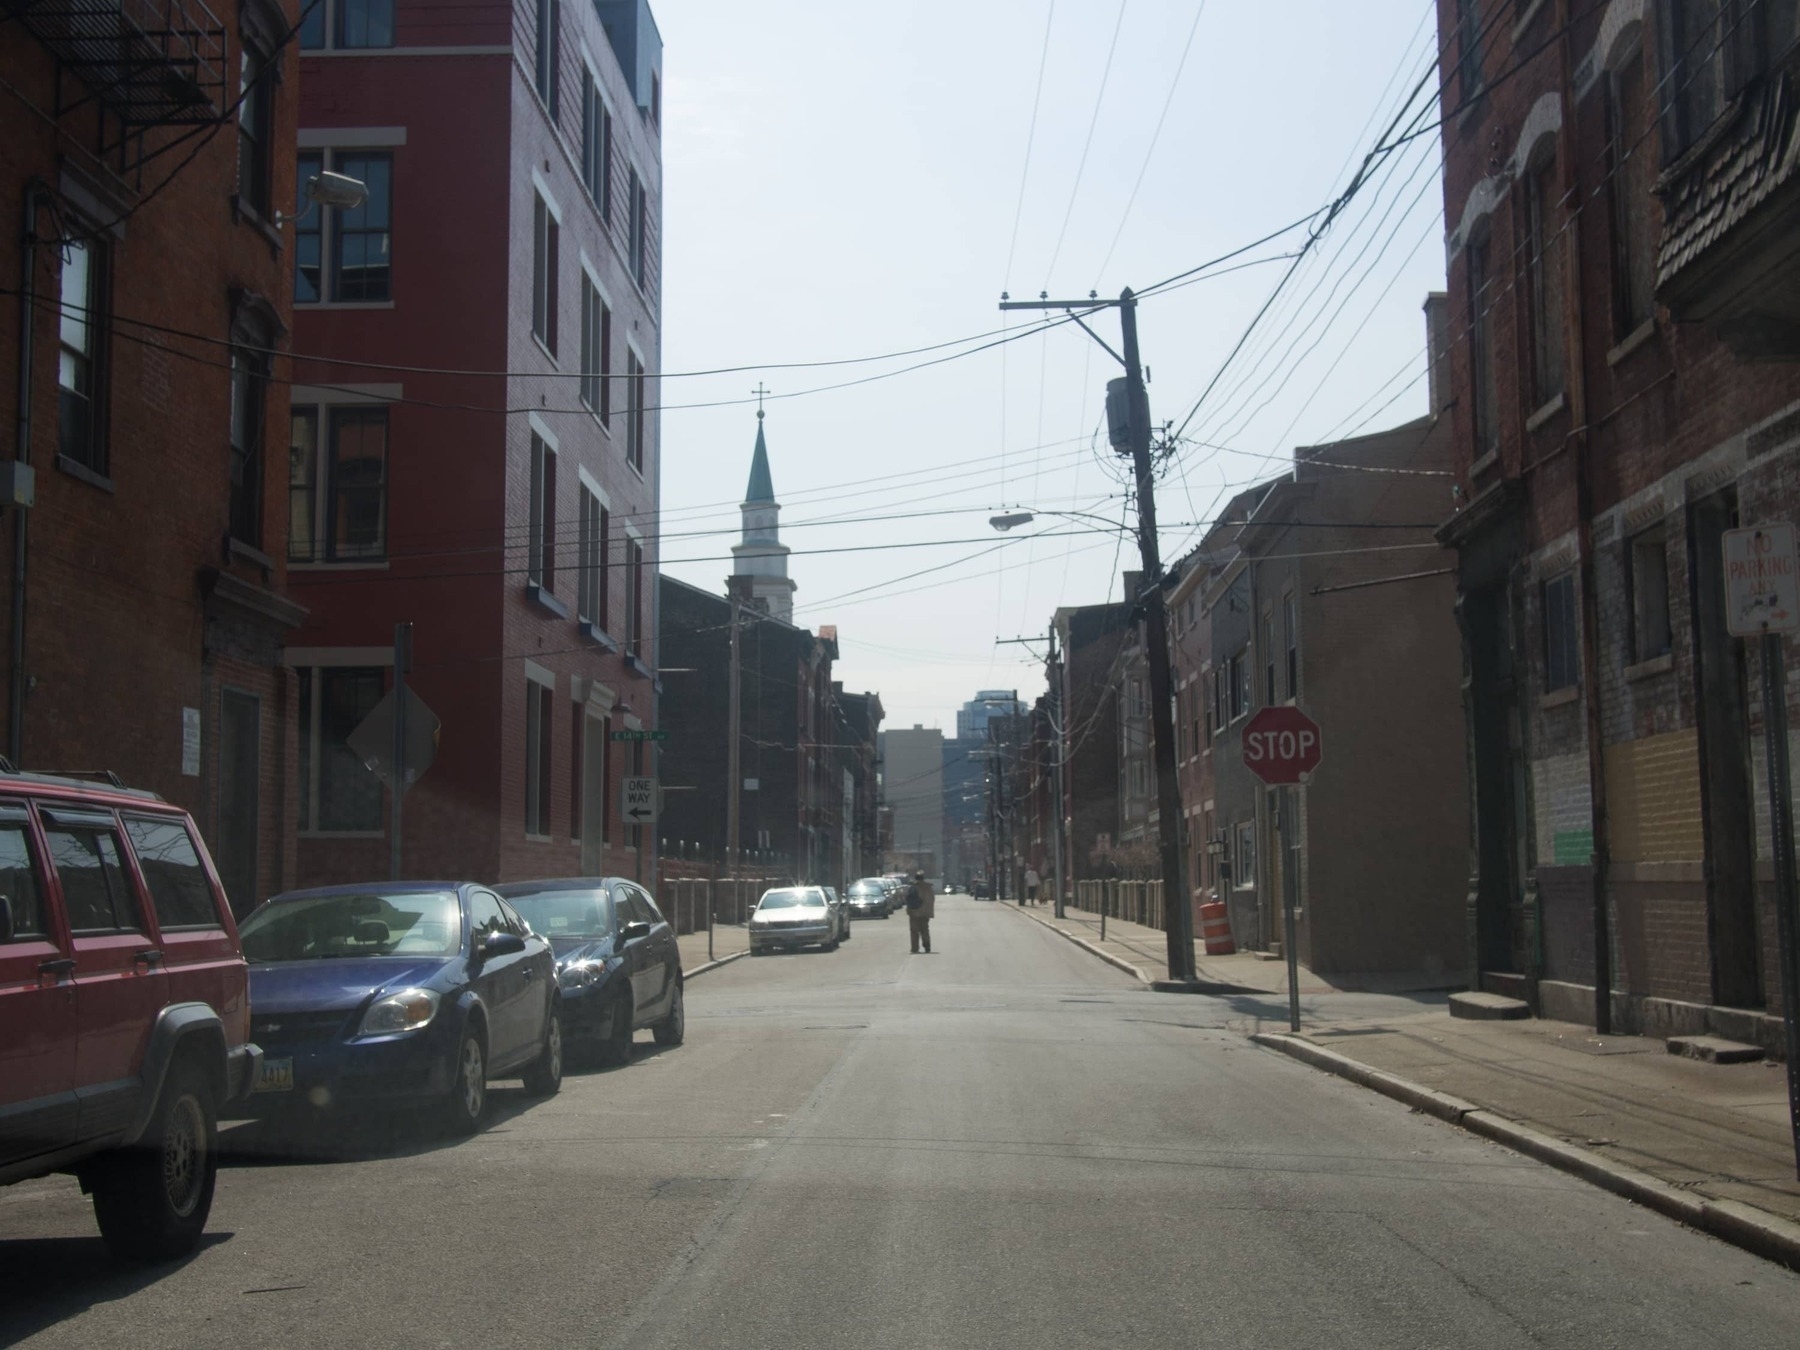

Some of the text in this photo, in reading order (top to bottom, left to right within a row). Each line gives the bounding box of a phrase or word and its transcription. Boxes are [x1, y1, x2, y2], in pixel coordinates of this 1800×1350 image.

[1746, 534, 1772, 556] NO
[1730, 555, 1793, 581] PARKING
[1749, 578, 1776, 597] ANY
[643, 732, 652, 740] ST
[1248, 730, 1315, 761] STOP
[629, 780, 651, 791] ONE
[628, 793, 650, 803] WAY
